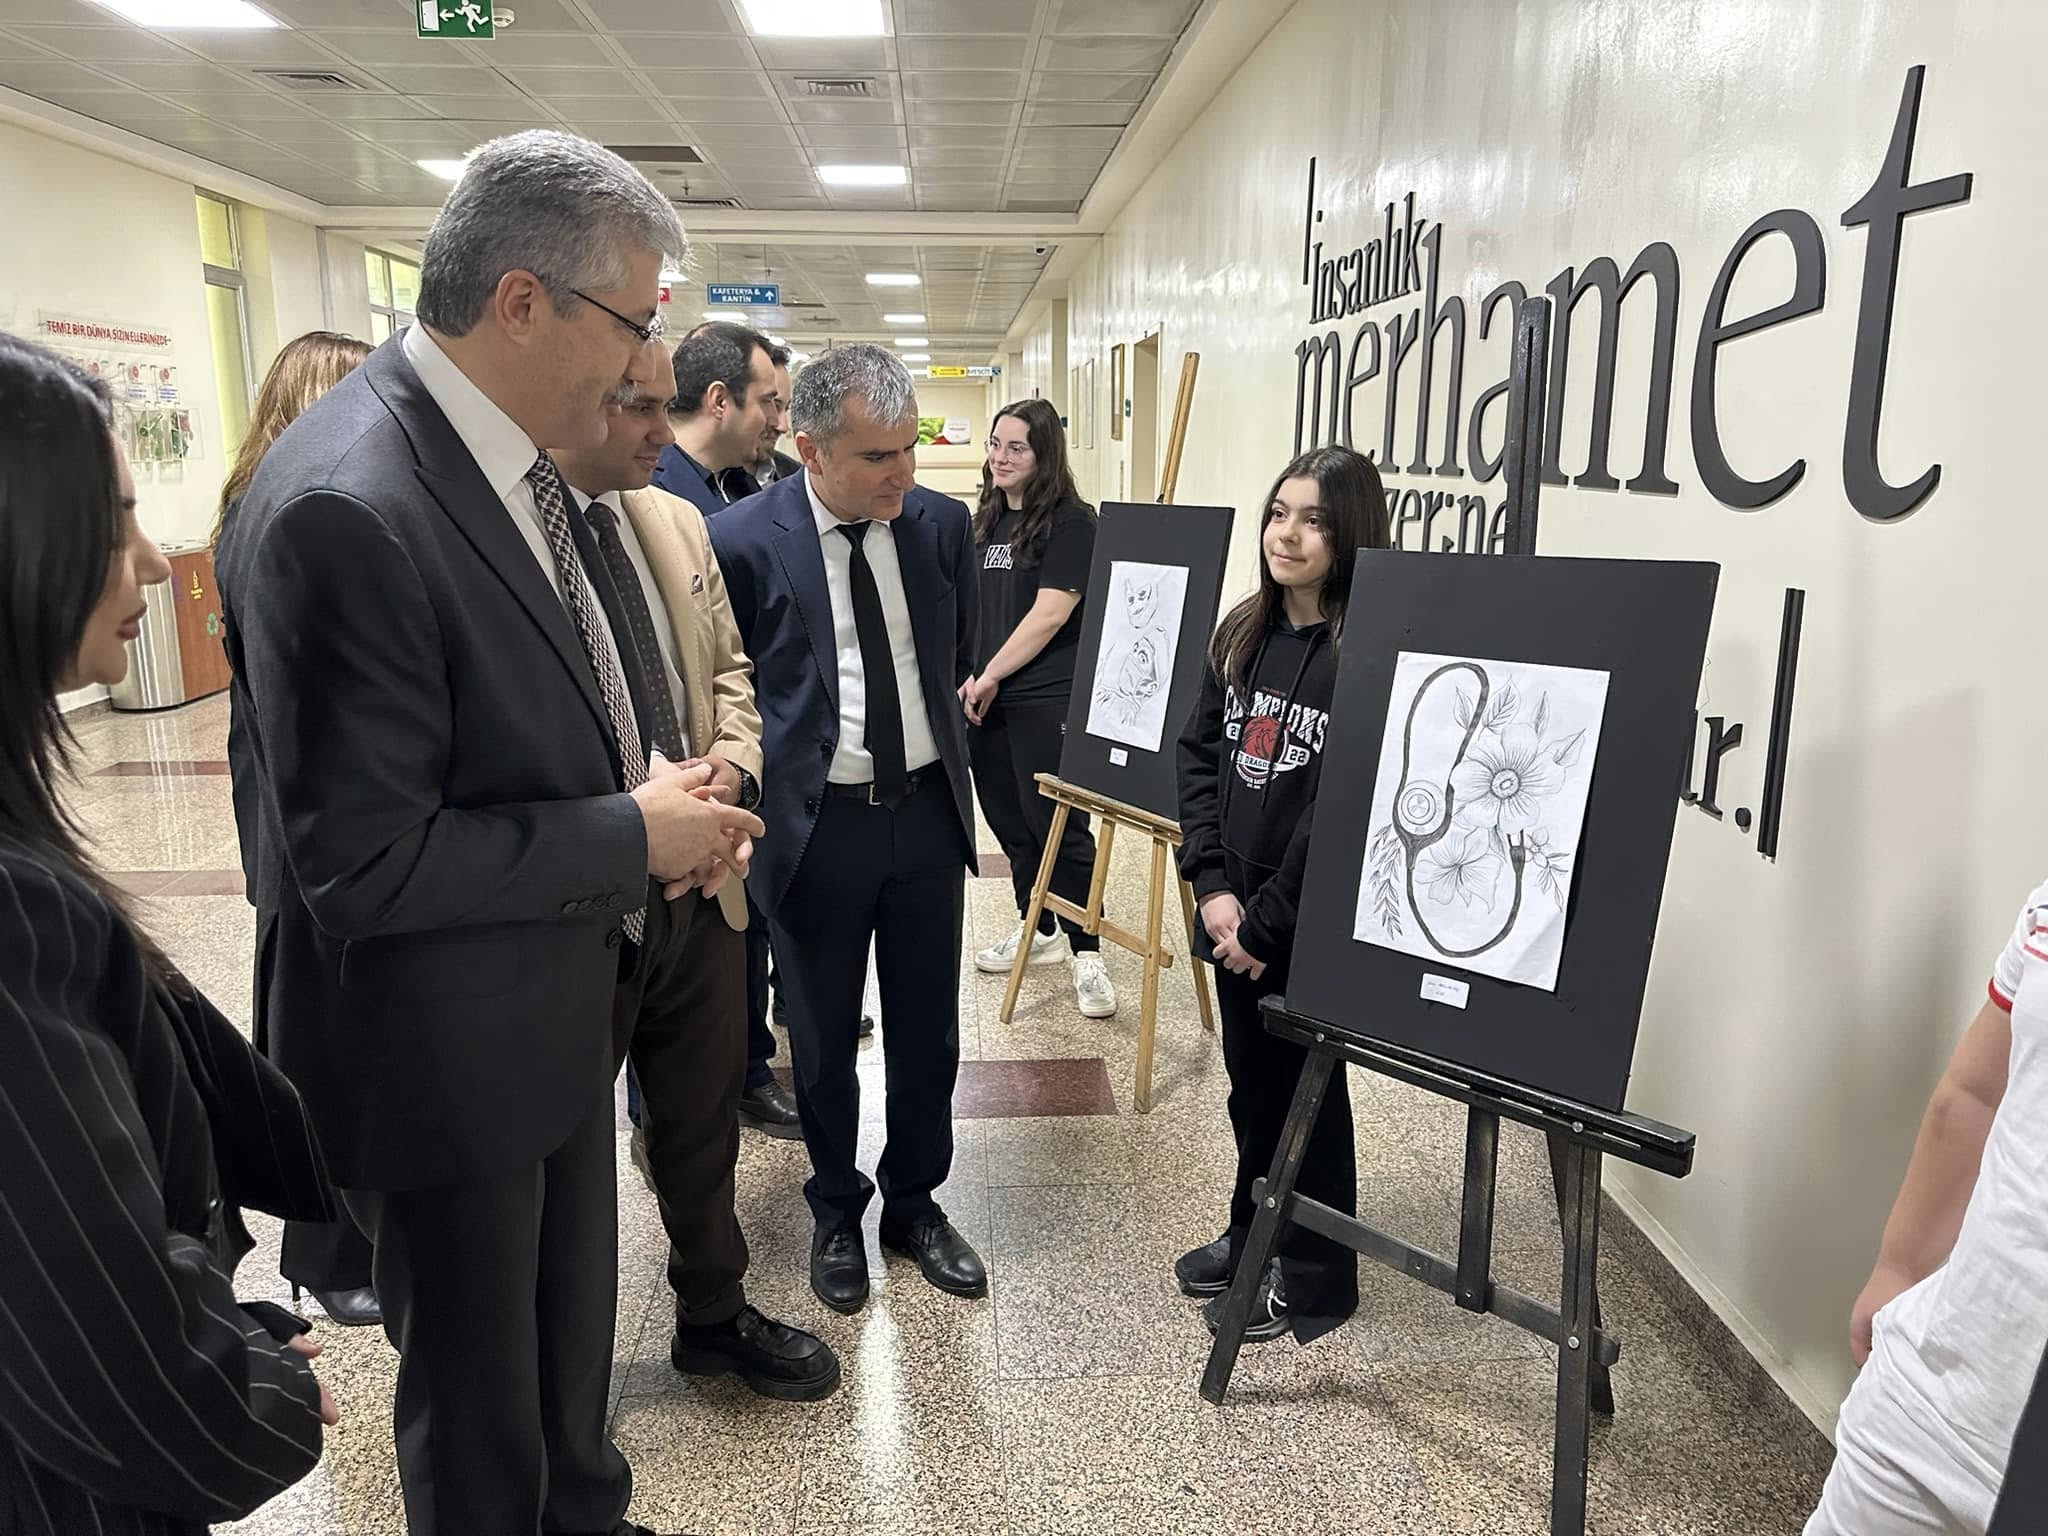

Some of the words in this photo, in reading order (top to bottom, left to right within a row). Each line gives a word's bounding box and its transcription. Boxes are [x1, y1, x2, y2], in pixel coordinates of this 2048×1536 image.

[1295, 64, 1974, 525] merhamet
[47, 320, 72, 335] TEMİZ
[72, 321, 86, 336] BİR
[86, 323, 111, 339] DÜNYA
[1289, 748, 1307, 763] 22
